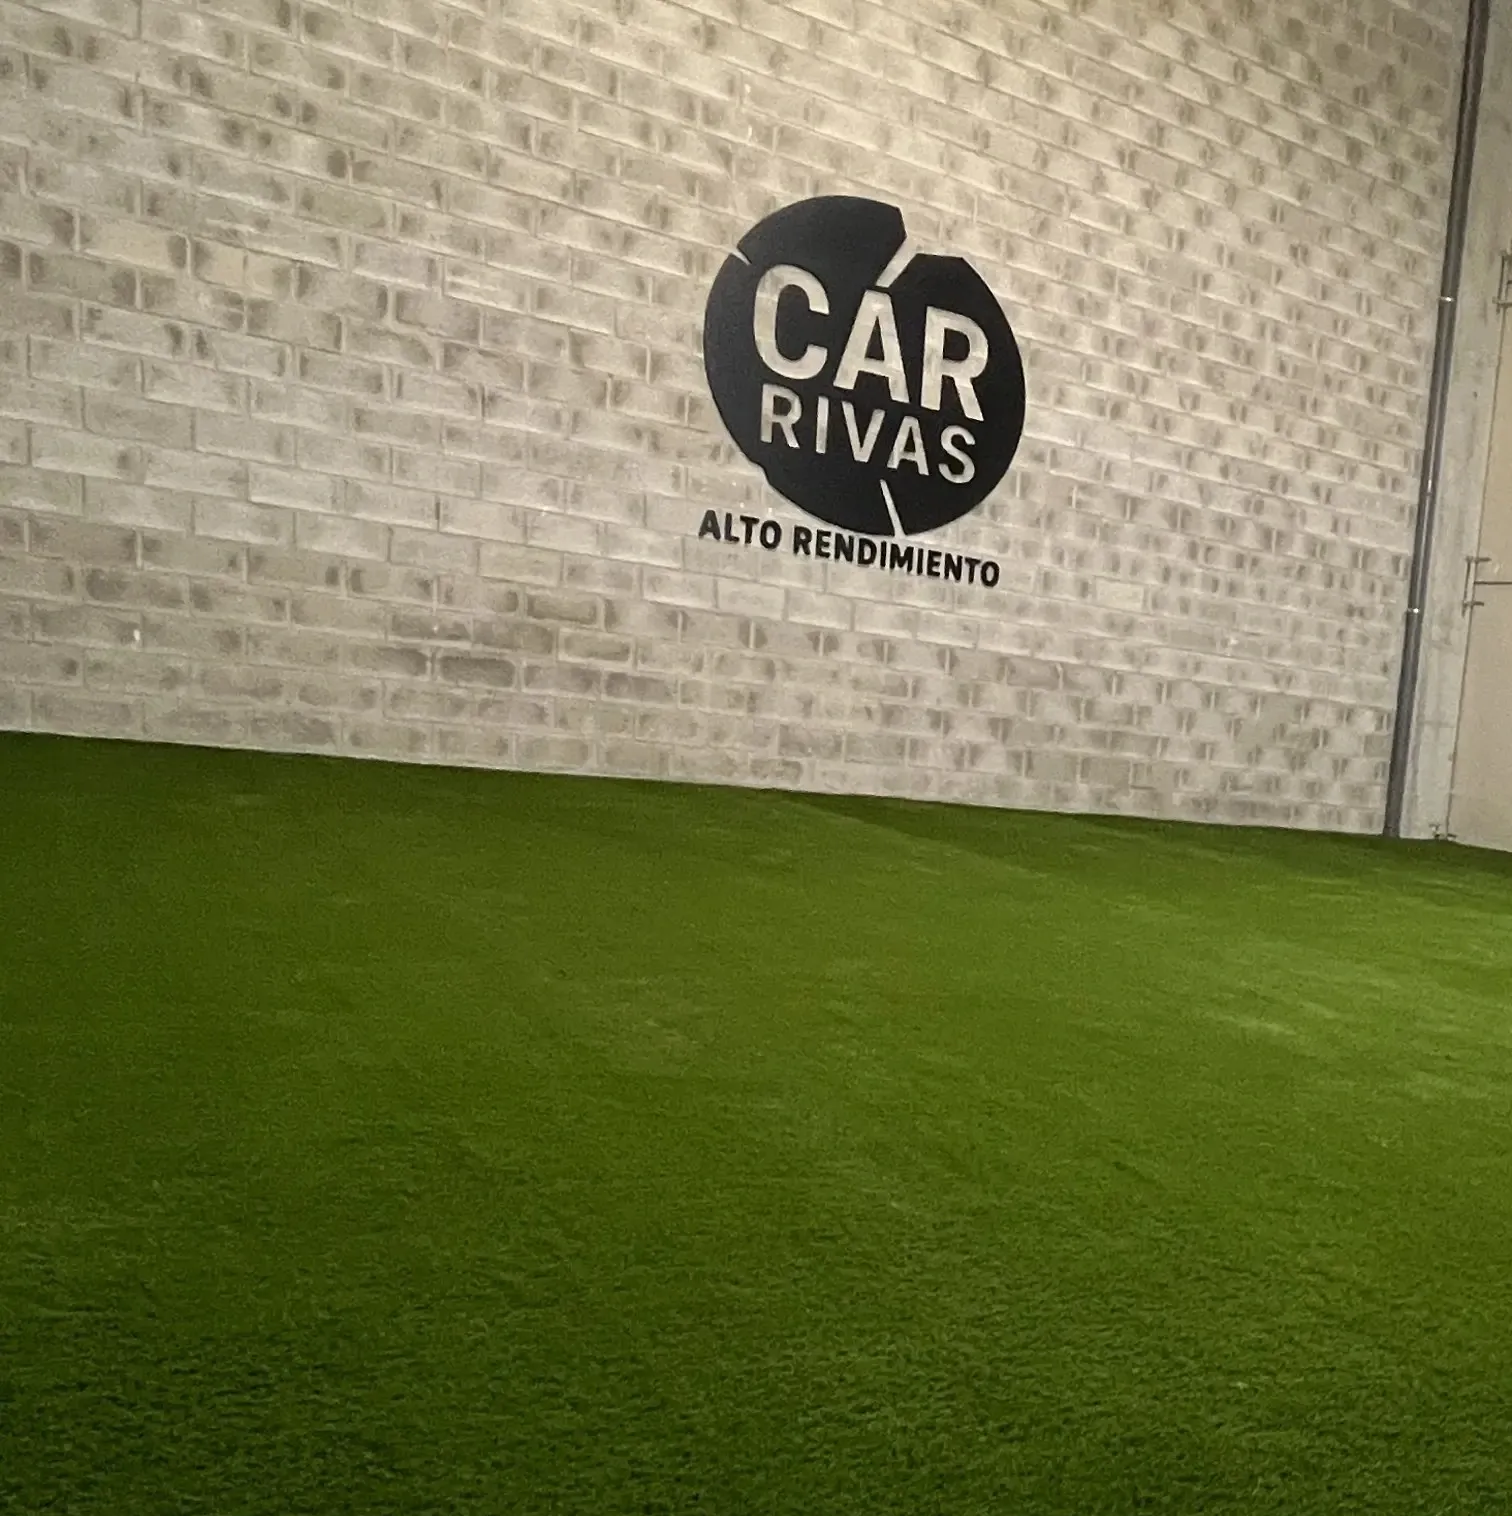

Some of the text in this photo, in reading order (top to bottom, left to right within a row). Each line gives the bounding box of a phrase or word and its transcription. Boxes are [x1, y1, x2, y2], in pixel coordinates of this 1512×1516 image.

[760, 383, 977, 485] RIVAS
[698, 508, 1001, 588] ALTO RENDIMIENTO
